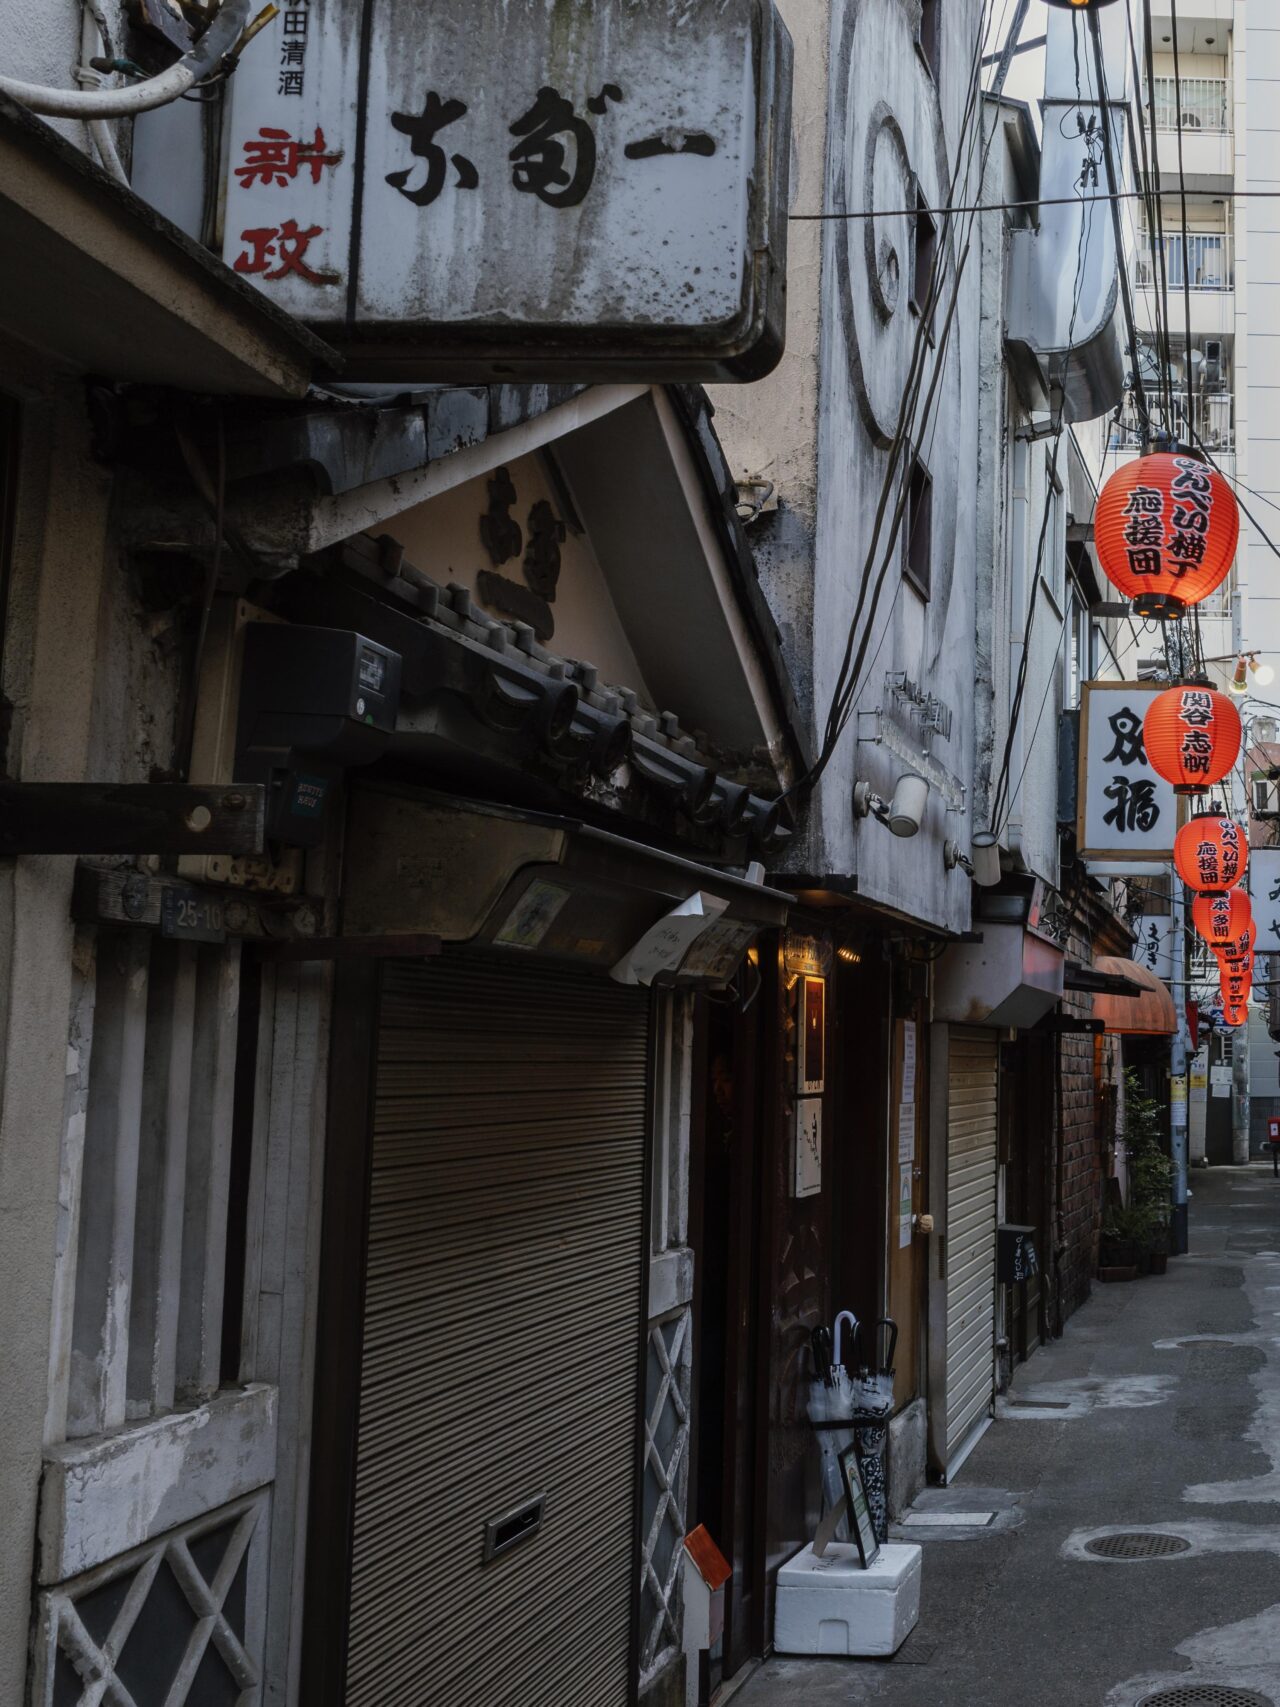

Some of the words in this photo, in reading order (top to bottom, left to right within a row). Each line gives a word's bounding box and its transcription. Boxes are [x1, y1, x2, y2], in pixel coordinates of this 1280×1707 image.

[279, 0, 309, 97] 田清酒
[232, 126, 343, 285] 新政
[1122, 485, 1165, 577] 応援団
[1166, 457, 1213, 577] のんべい横丁
[1180, 690, 1214, 775] 関谷志帆
[1196, 841, 1219, 885] 応援団
[1219, 819, 1240, 884] のんべい横丁
[177, 899, 221, 930] 25-10
